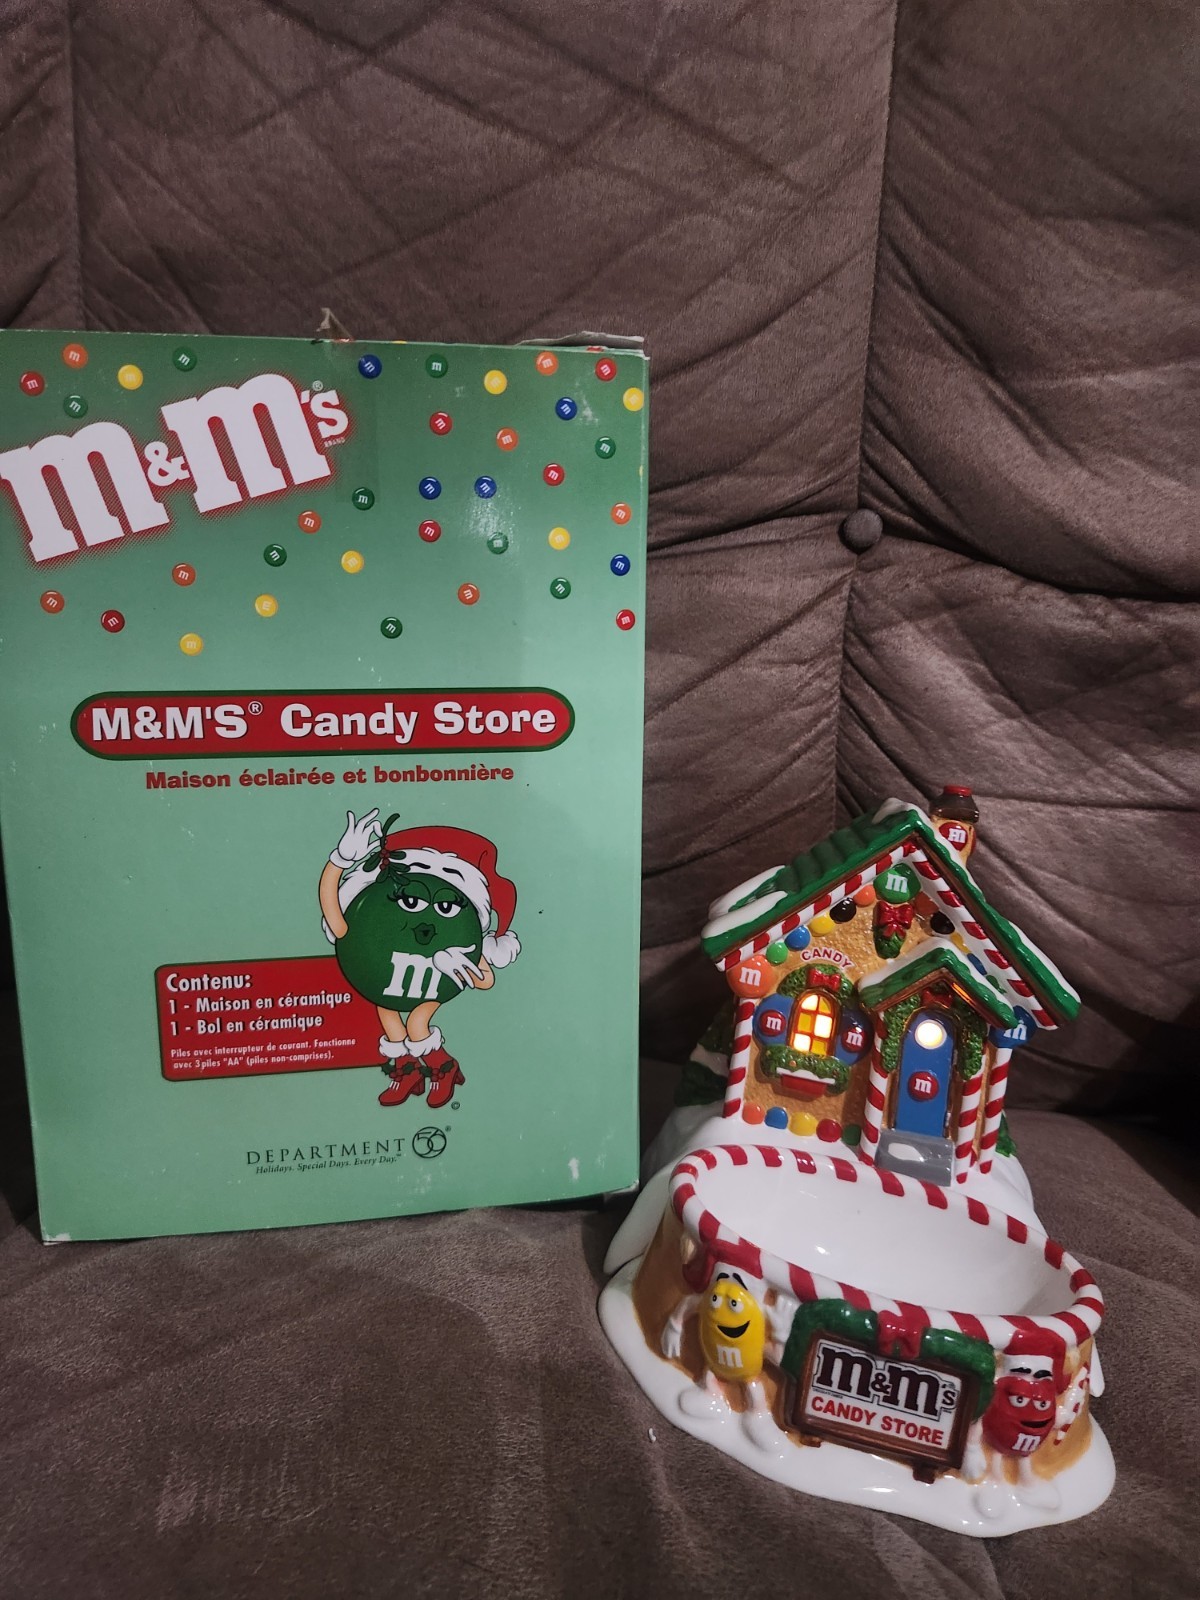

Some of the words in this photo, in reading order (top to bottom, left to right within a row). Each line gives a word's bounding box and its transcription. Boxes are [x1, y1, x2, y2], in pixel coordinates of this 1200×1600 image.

[69, 351, 80, 361] m
[179, 354, 190, 365] m
[365, 362, 375, 372] m
[432, 362, 441, 371] m
[601, 365, 610, 375] m
[27, 380, 38, 389] m
[70, 401, 80, 412] m
[561, 404, 571, 414] m
[436, 419, 445, 429] m
[600, 443, 610, 453] m
[549, 470, 558, 480] m
[425, 484, 434, 493] m
[480, 483, 490, 493] m
[358, 495, 367, 503] m
[616, 510, 625, 518] m
[304, 518, 314, 527] m
[425, 527, 434, 536] m
[270, 551, 279, 560] m
[616, 561, 624, 570] m
[179, 571, 188, 579] m
[556, 584, 565, 593] m
[464, 590, 472, 599] m
[47, 598, 57, 607] m
[108, 617, 118, 626] m
[386, 624, 395, 633] m
[280, 702, 418, 744] Candy
[434, 701, 556, 735] Store
[146, 771, 231, 789] Maison
[239, 767, 335, 786] éclairée
[343, 768, 367, 784] et
[374, 763, 514, 783] bonbonnière
[886, 873, 909, 892] m
[800, 948, 854, 969] CANDY
[382, 951, 443, 1000] m
[739, 966, 761, 987] m
[166, 973, 251, 992] Contenu:
[169, 999, 176, 1014] 1
[196, 997, 250, 1013] Maison
[255, 997, 273, 1009] en
[278, 990, 352, 1009] céramique
[170, 1021, 177, 1036] 1
[197, 1018, 221, 1035] Bol
[227, 1020, 244, 1032] en
[250, 1013, 323, 1032] céramique
[766, 1015, 782, 1030] m
[847, 1032, 863, 1047] m
[171, 1048, 190, 1057] Piles
[215, 1045, 264, 1055] interrupteur
[267, 1042, 276, 1051] de
[279, 1041, 312, 1050] courant.
[314, 1038, 356, 1048] Fonctionne
[195, 1059, 200, 1068] 3
[201, 1059, 221, 1070] piles
[246, 1055, 268, 1066] (piles
[914, 1077, 932, 1093] m
[246, 1138, 406, 1165] DEPARTMENT
[256, 1163, 294, 1174] Holidays.
[297, 1160, 327, 1172] Special
[329, 1159, 351, 1169] Days.
[354, 1157, 377, 1166] Every
[716, 1344, 744, 1368] m
[811, 1396, 877, 1426] CANDY
[881, 1415, 945, 1446] STORE
[1011, 1433, 1041, 1452] m
